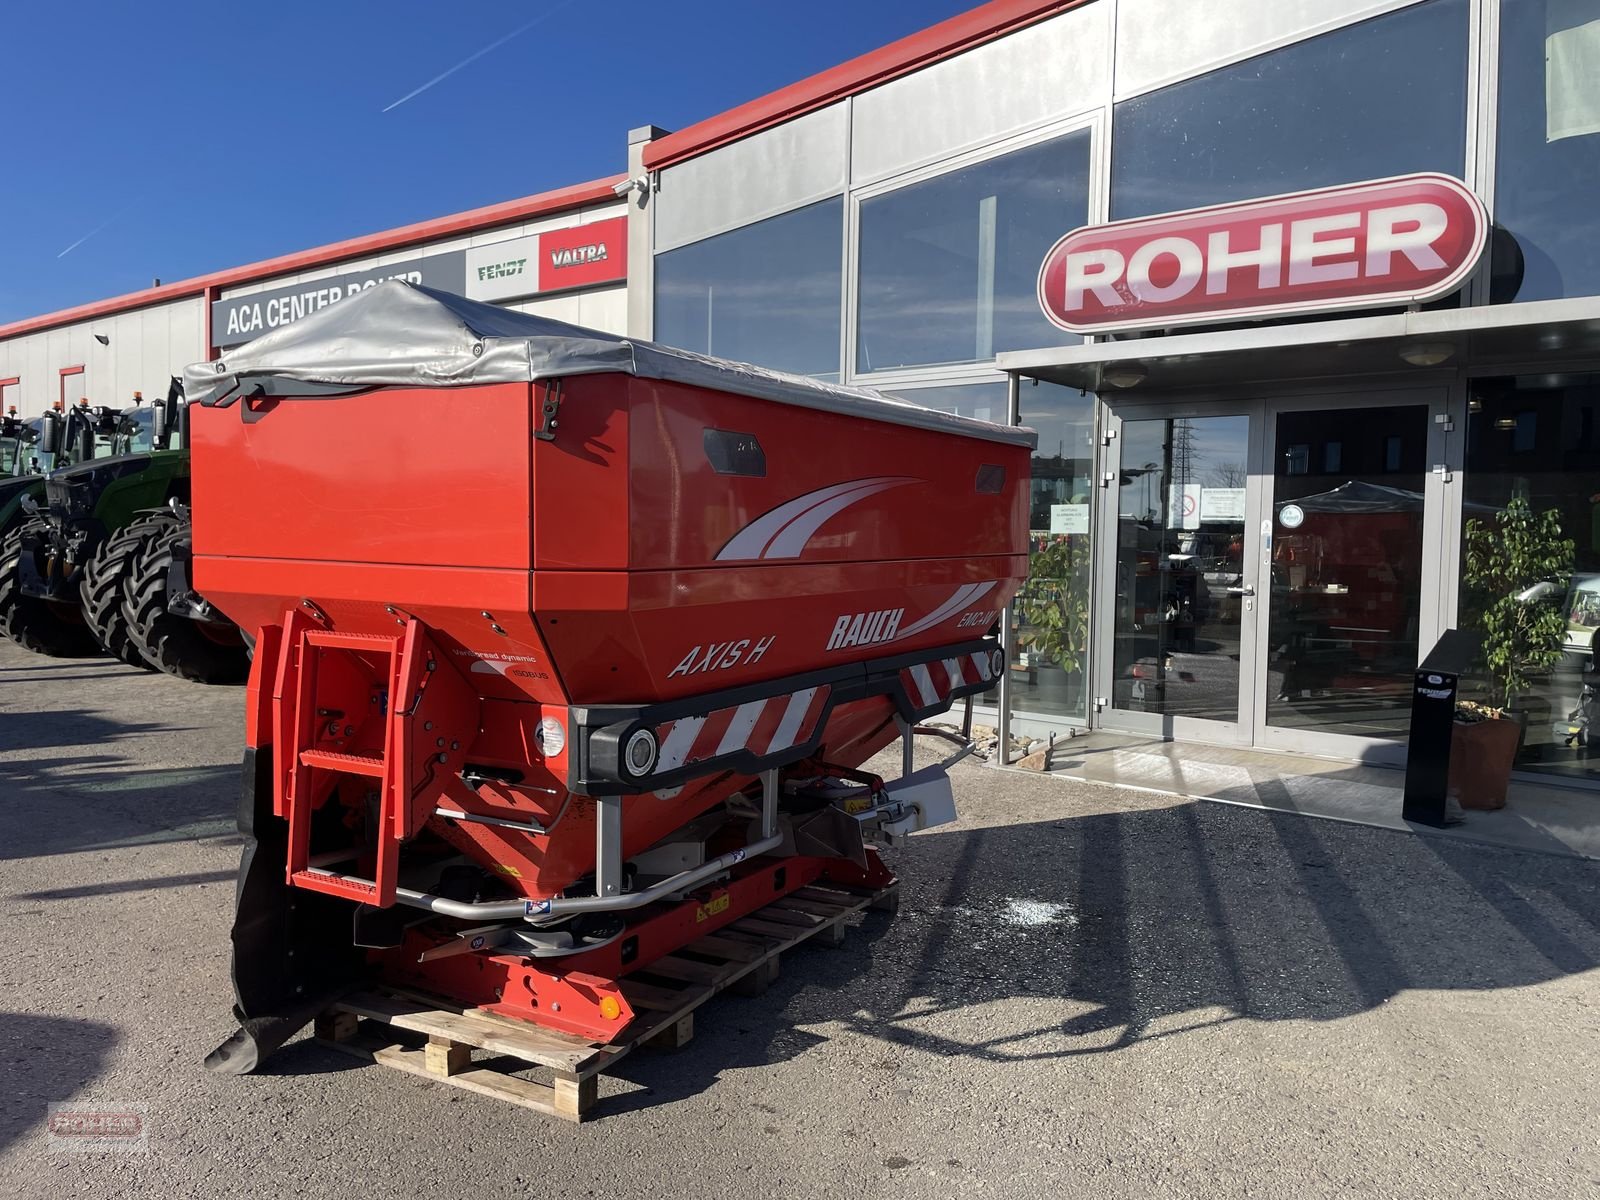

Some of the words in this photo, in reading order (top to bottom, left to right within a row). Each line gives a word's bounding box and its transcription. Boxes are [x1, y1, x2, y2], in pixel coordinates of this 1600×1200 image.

[478, 259, 526, 280] FENDT
[551, 242, 607, 269] VALTRA
[1064, 203, 1449, 311] ROHER
[227, 303, 263, 335] ACA
[267, 286, 342, 327] CENTER
[826, 608, 905, 651] RAUCH
[501, 653, 537, 663] dynamic
[667, 639, 749, 678] AXIS
[747, 635, 775, 663] H
[512, 669, 549, 680] ISOBUS
